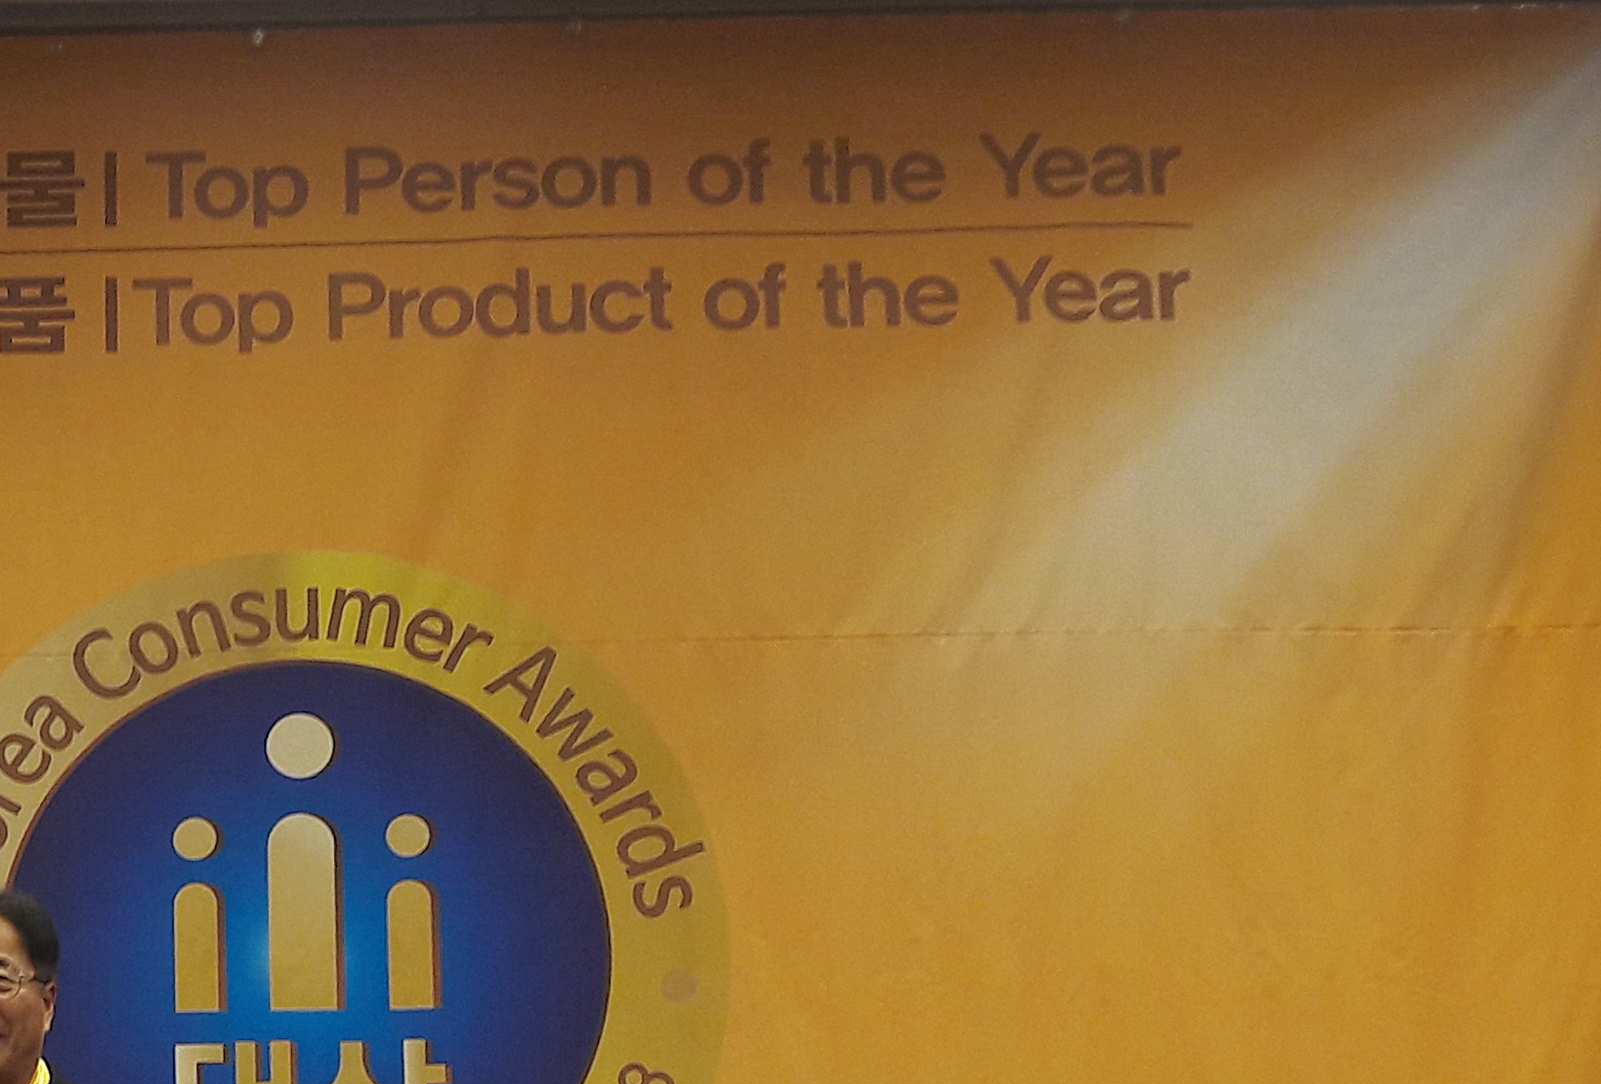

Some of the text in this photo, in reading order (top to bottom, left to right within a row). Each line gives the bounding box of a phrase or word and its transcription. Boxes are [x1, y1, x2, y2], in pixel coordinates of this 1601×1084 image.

[145, 132, 1181, 228] Top Person of the Year
[133, 256, 1191, 352] Top Product of the Year
[72, 587, 494, 700] Consumer
[483, 646, 706, 920] Awards
